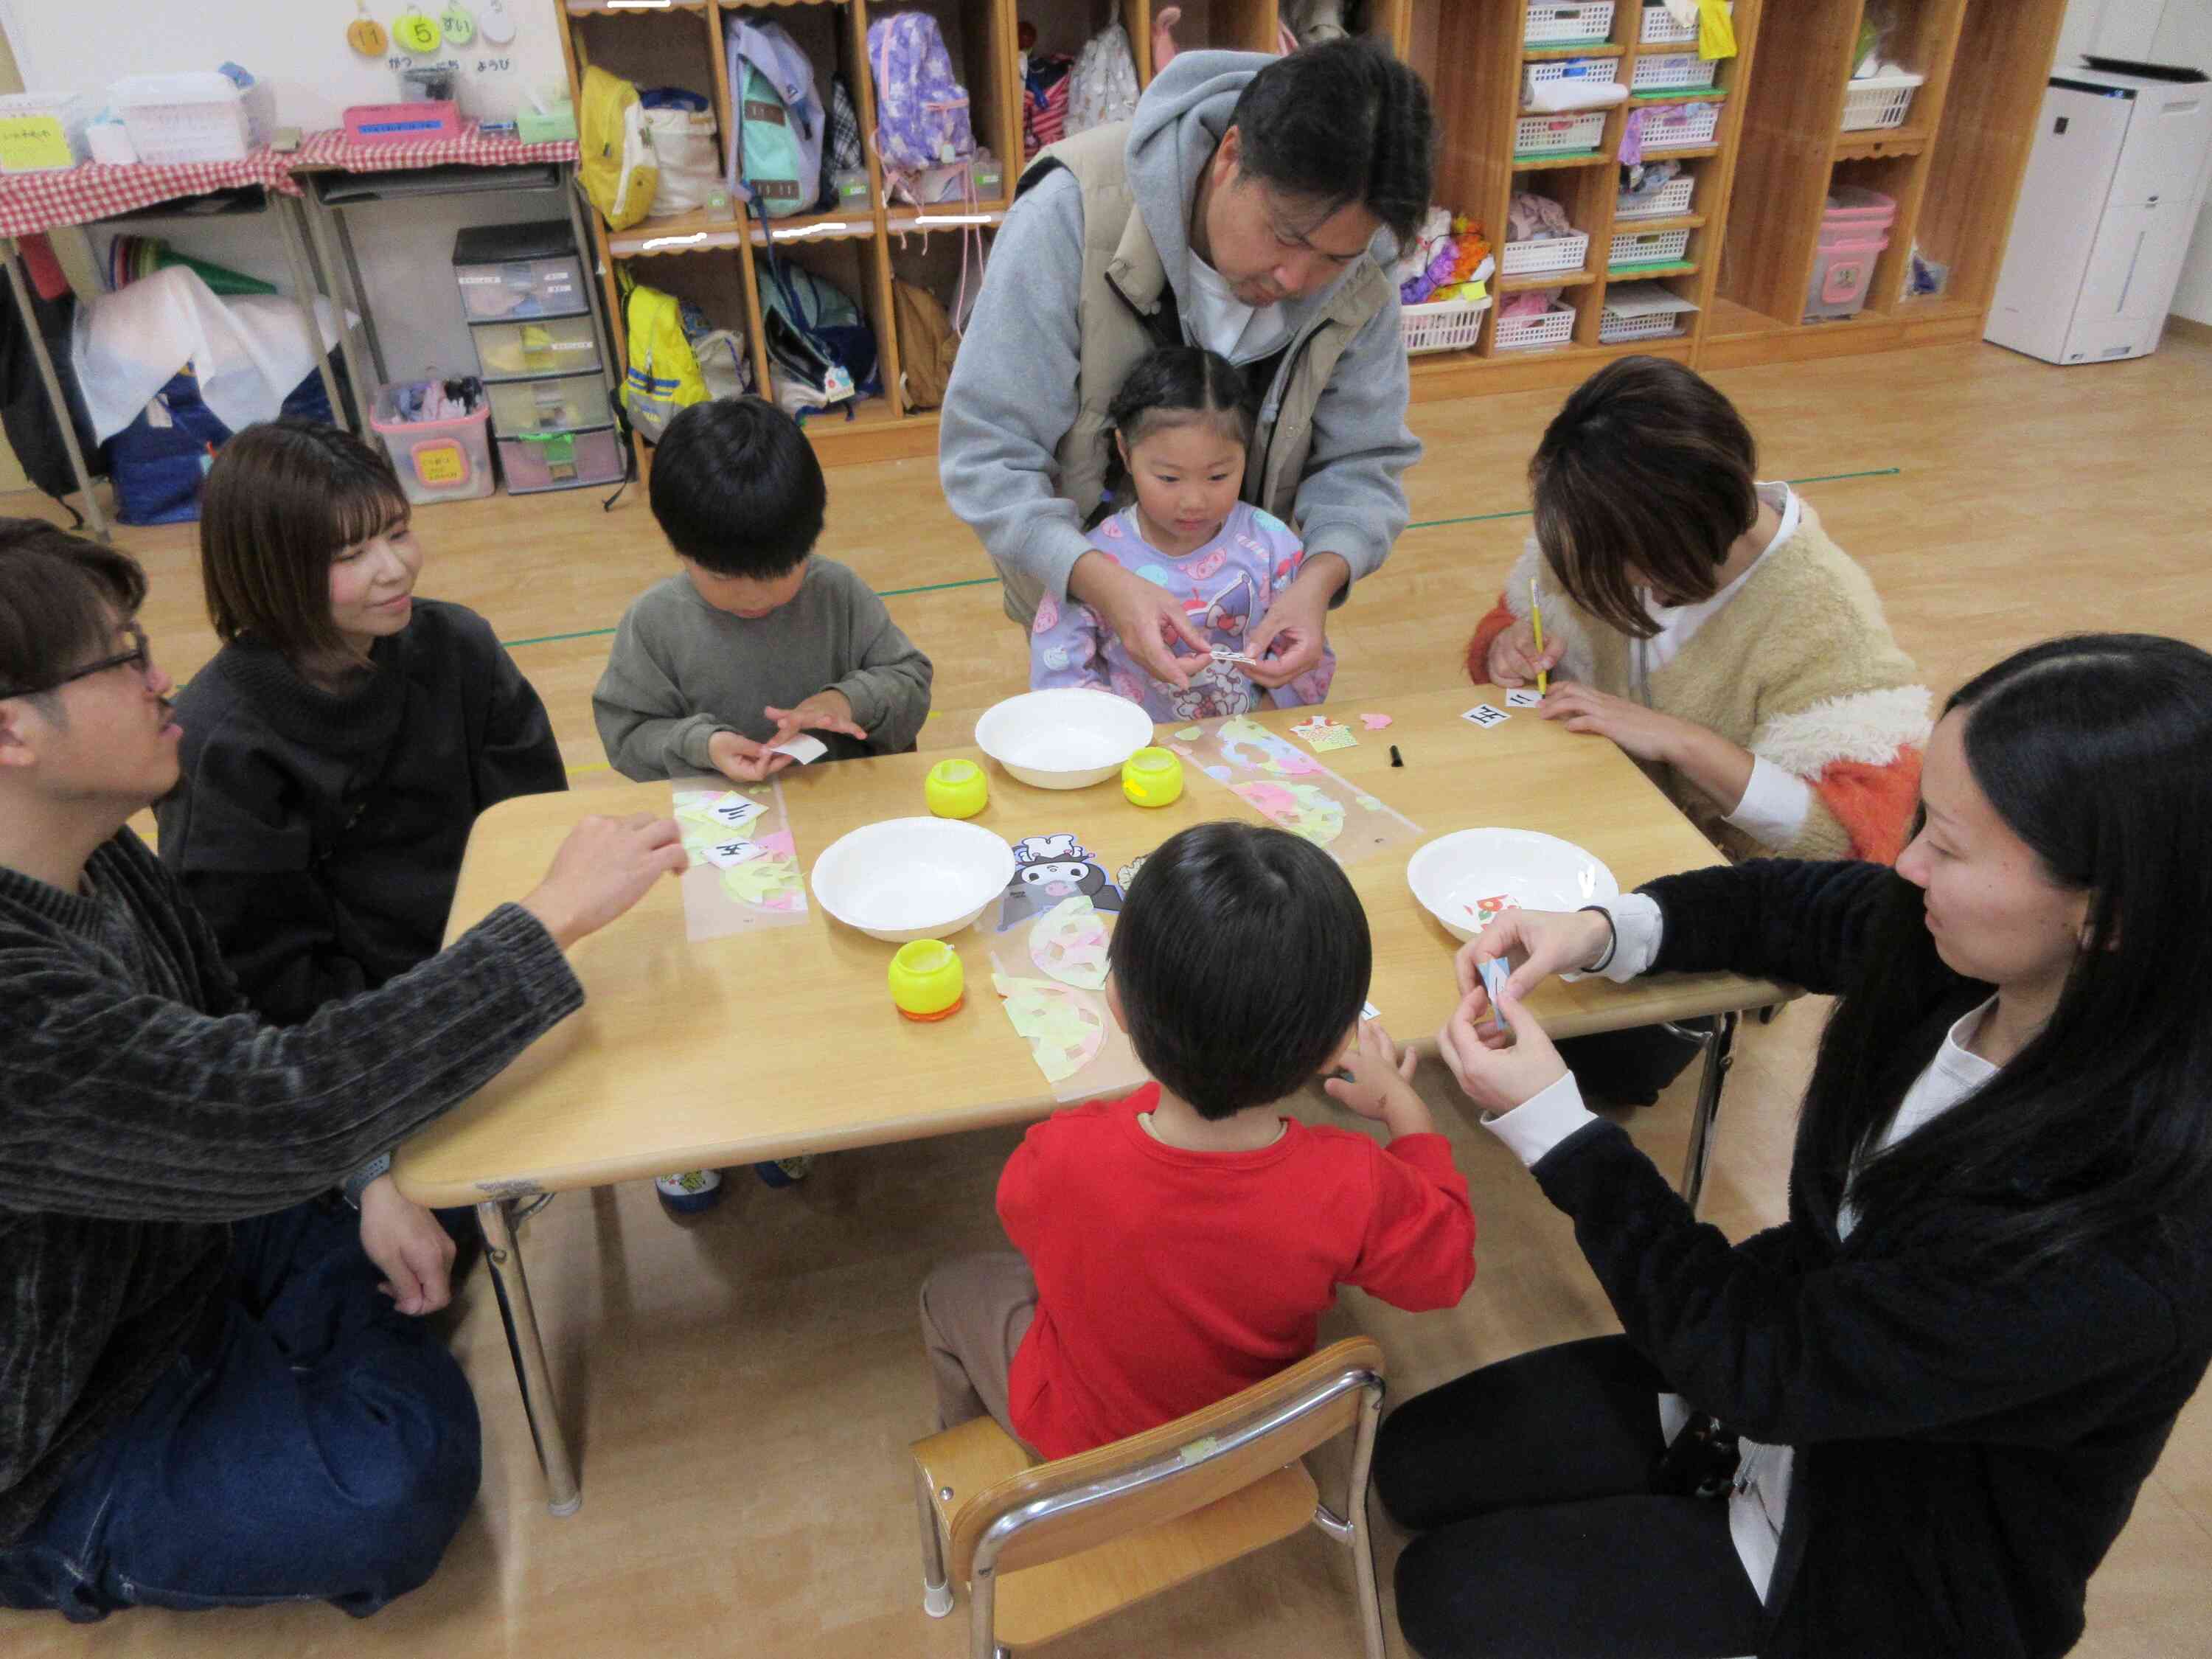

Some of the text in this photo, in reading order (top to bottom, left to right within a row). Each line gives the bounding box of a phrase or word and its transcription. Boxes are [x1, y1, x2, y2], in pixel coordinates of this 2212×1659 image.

[358, 29, 383, 46] 11
[413, 23, 431, 44] 5
[477, 58, 510, 72] ようび
